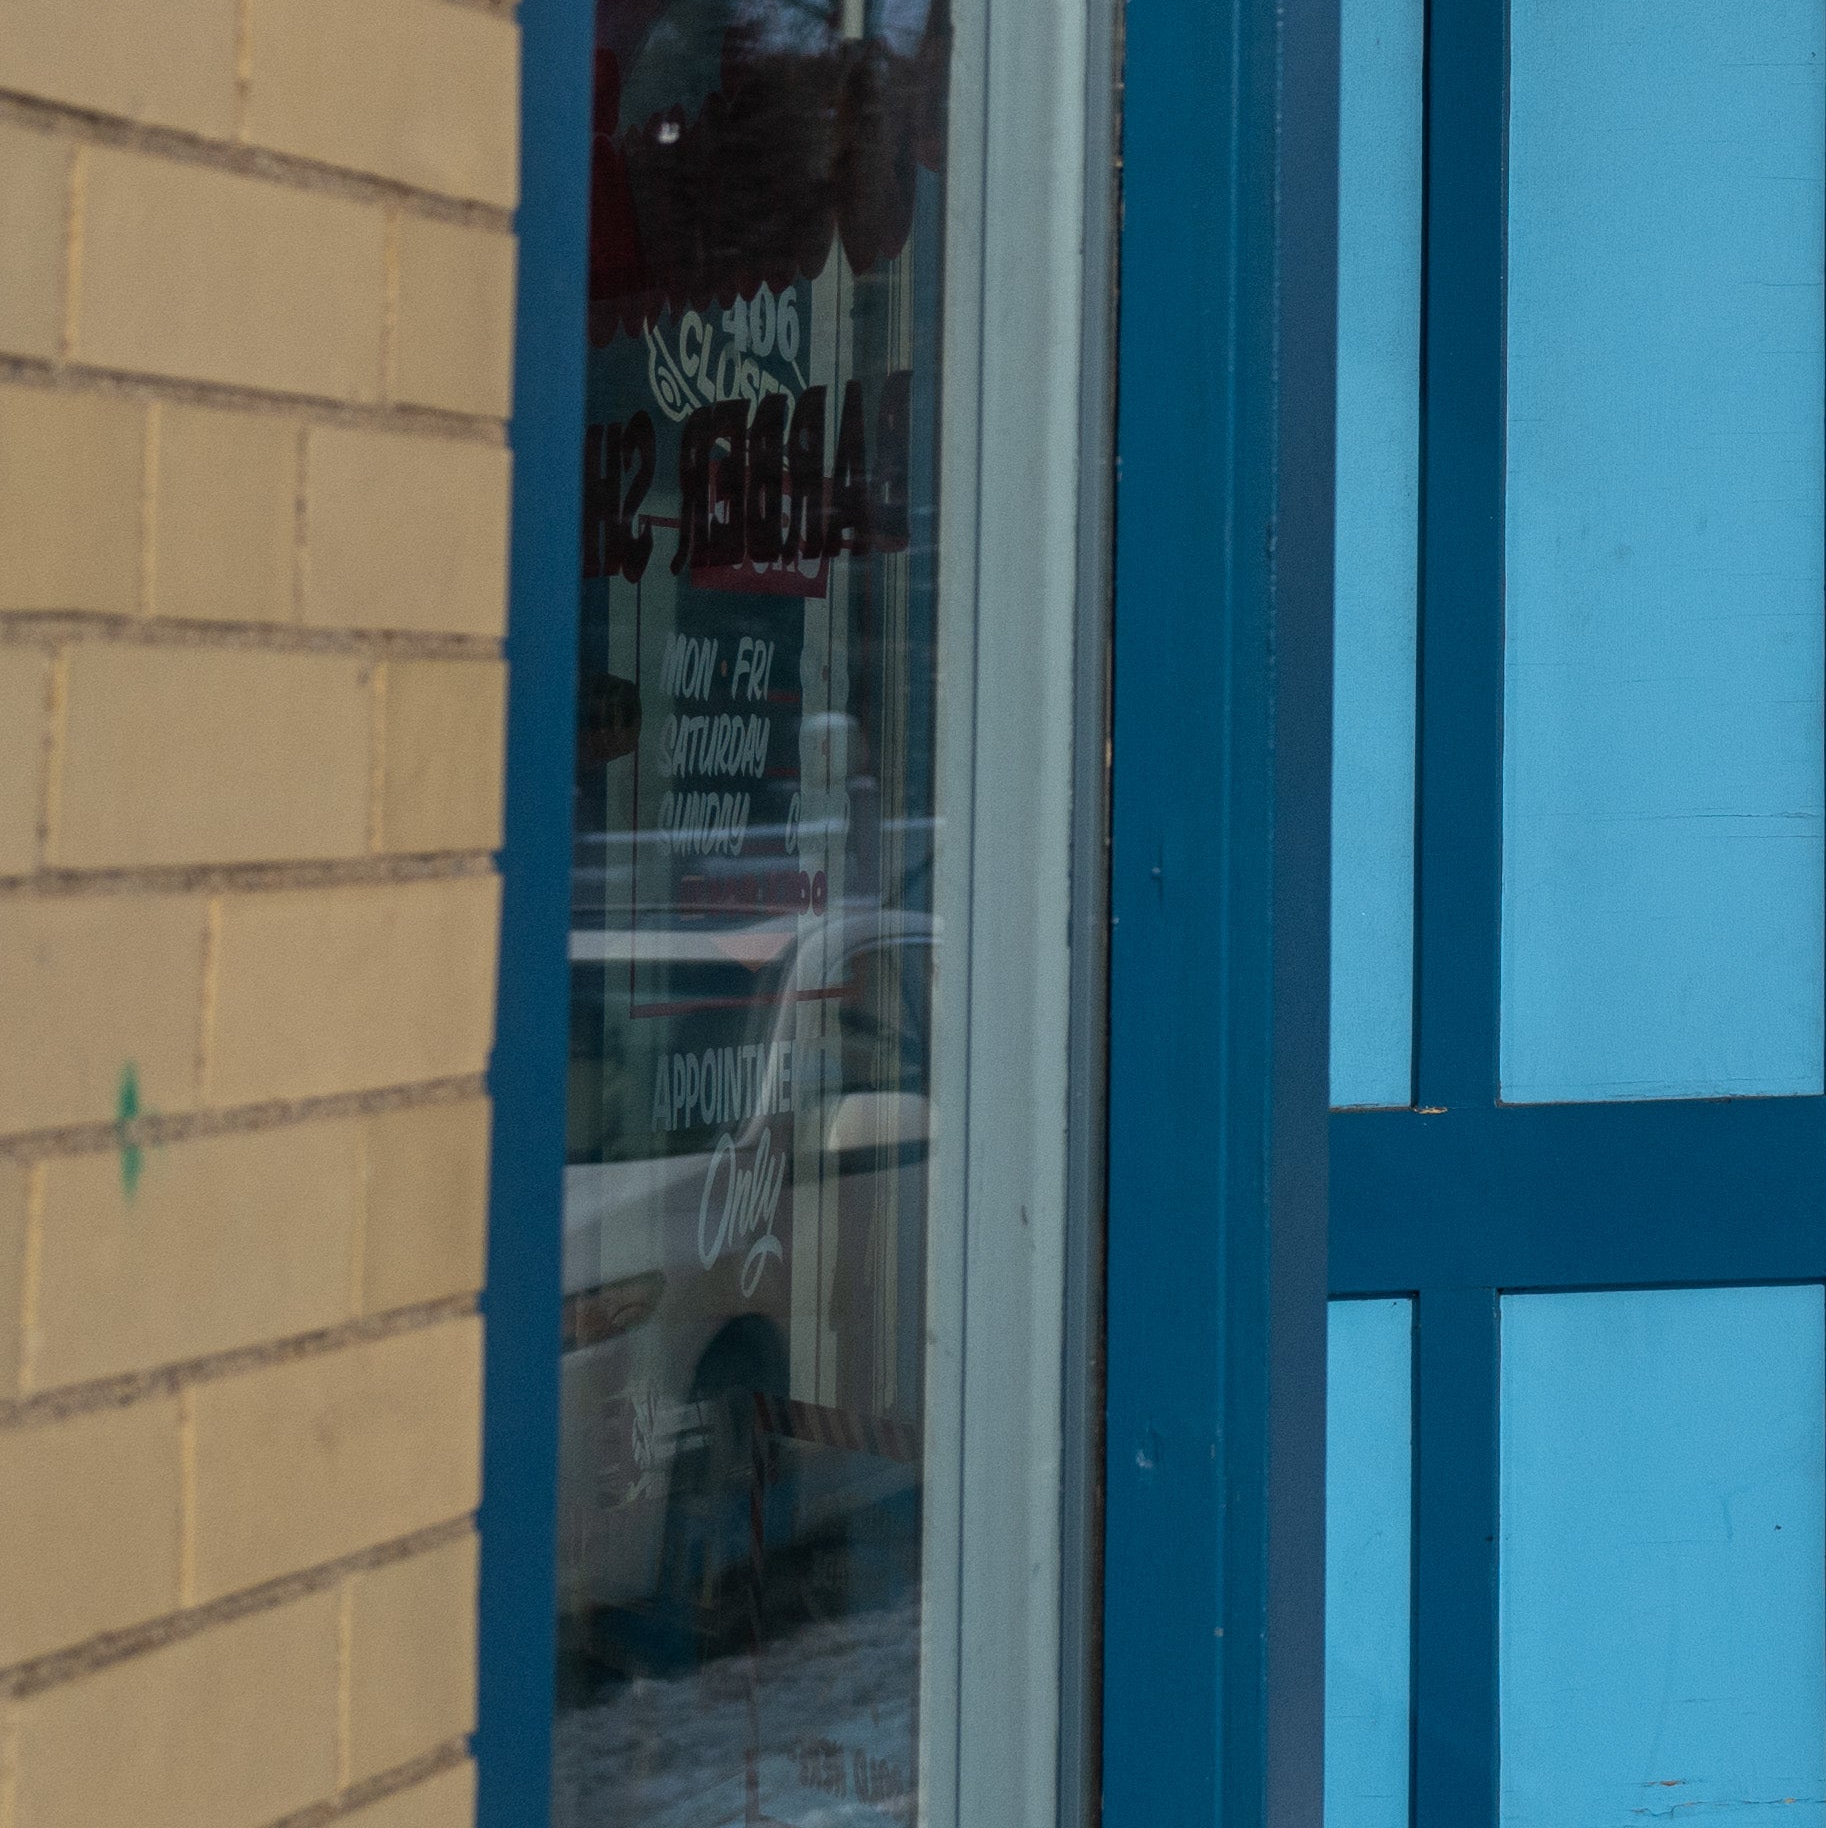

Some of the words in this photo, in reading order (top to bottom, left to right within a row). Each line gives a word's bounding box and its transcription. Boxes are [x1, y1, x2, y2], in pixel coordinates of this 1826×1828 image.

[722, 281, 800, 362] 406
[662, 633, 718, 701] MON
[732, 636, 775, 702] FRI
[657, 713, 771, 779] SATURDAY
[656, 791, 751, 859] SUNDAY
[699, 1128, 788, 1299] Only
